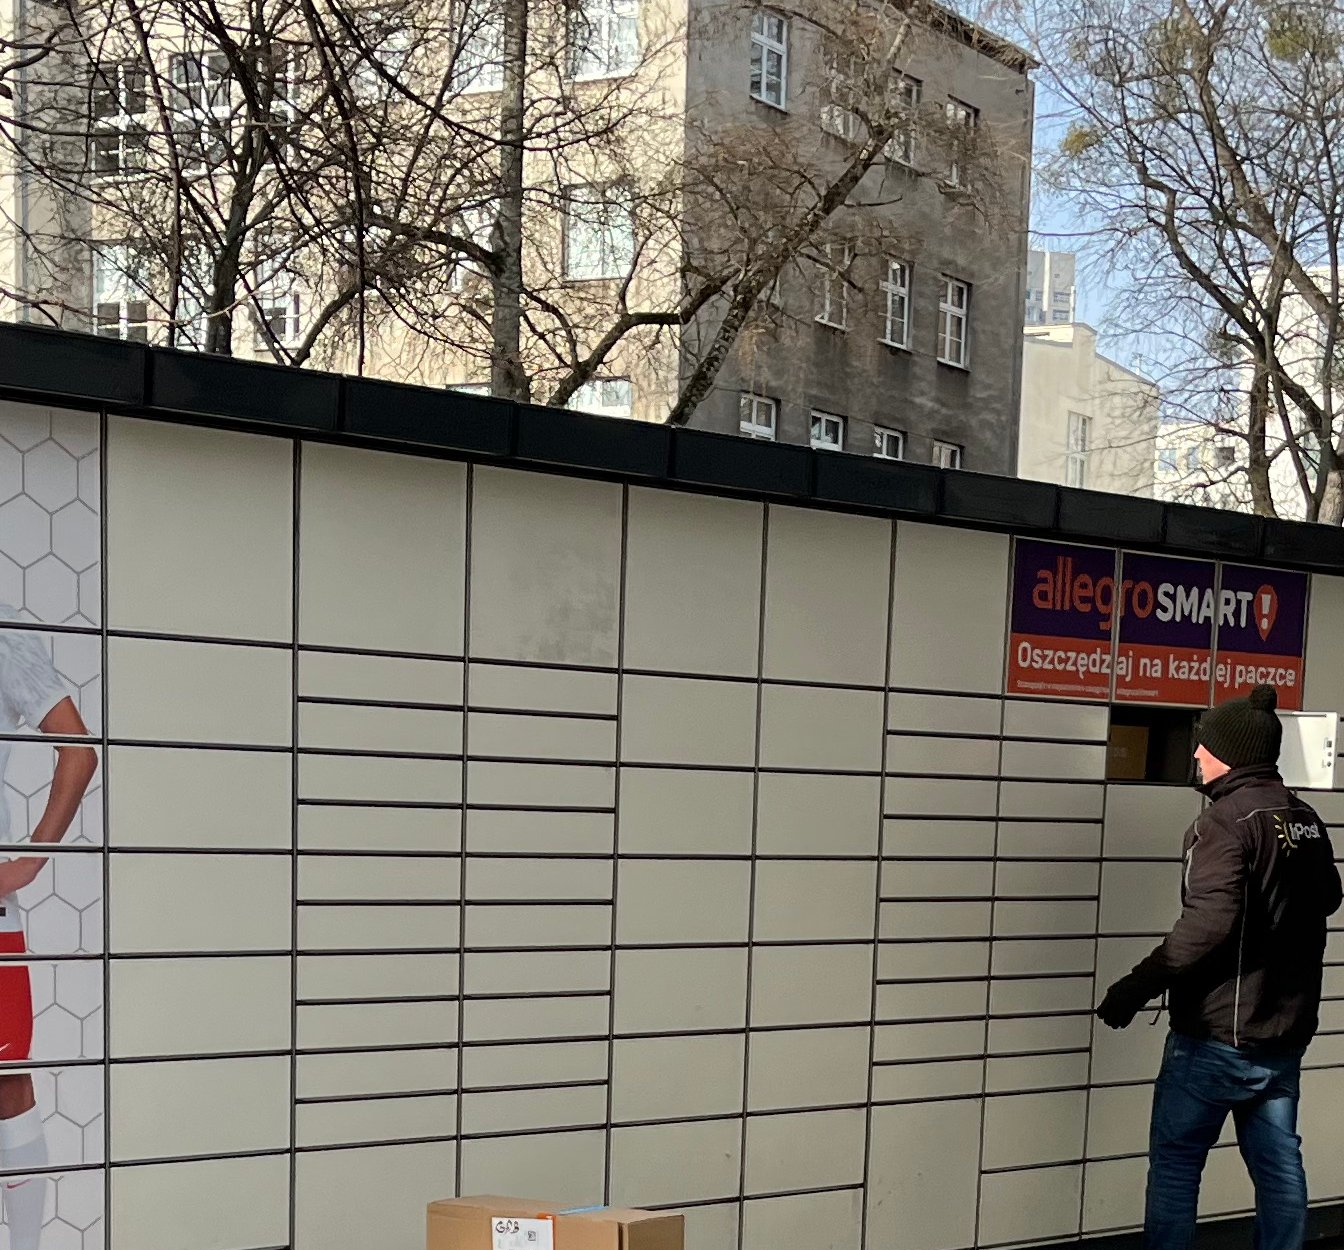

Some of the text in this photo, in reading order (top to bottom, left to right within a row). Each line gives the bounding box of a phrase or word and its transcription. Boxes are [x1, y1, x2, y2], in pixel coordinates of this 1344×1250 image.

[1032, 555, 1154, 631] allegro
[1017, 641, 1296, 689] Oszczędzaj na każdej paczce
